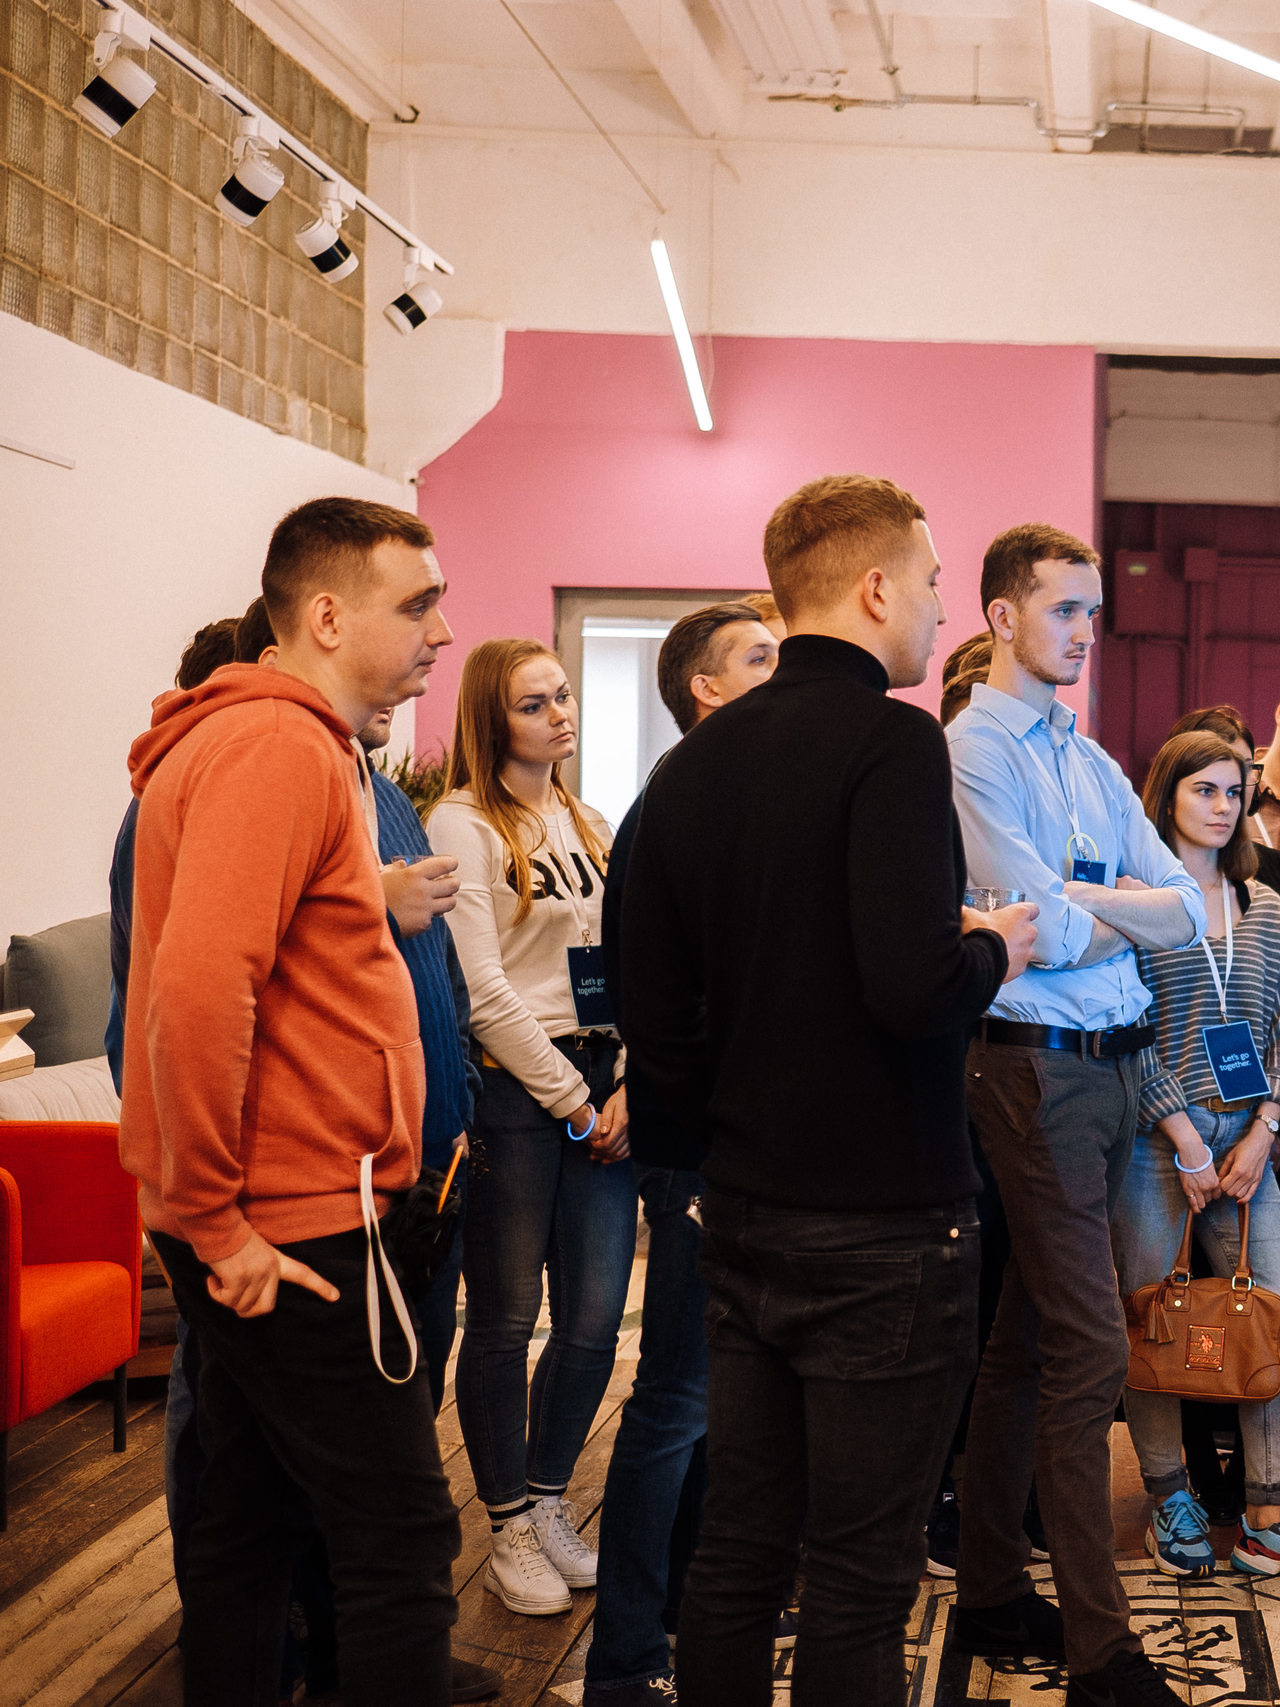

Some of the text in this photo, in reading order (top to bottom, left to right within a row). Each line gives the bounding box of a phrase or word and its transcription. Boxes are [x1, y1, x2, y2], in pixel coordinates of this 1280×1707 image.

[581, 977, 606, 986] Let's go
[1222, 1052, 1250, 1063] Let's go
